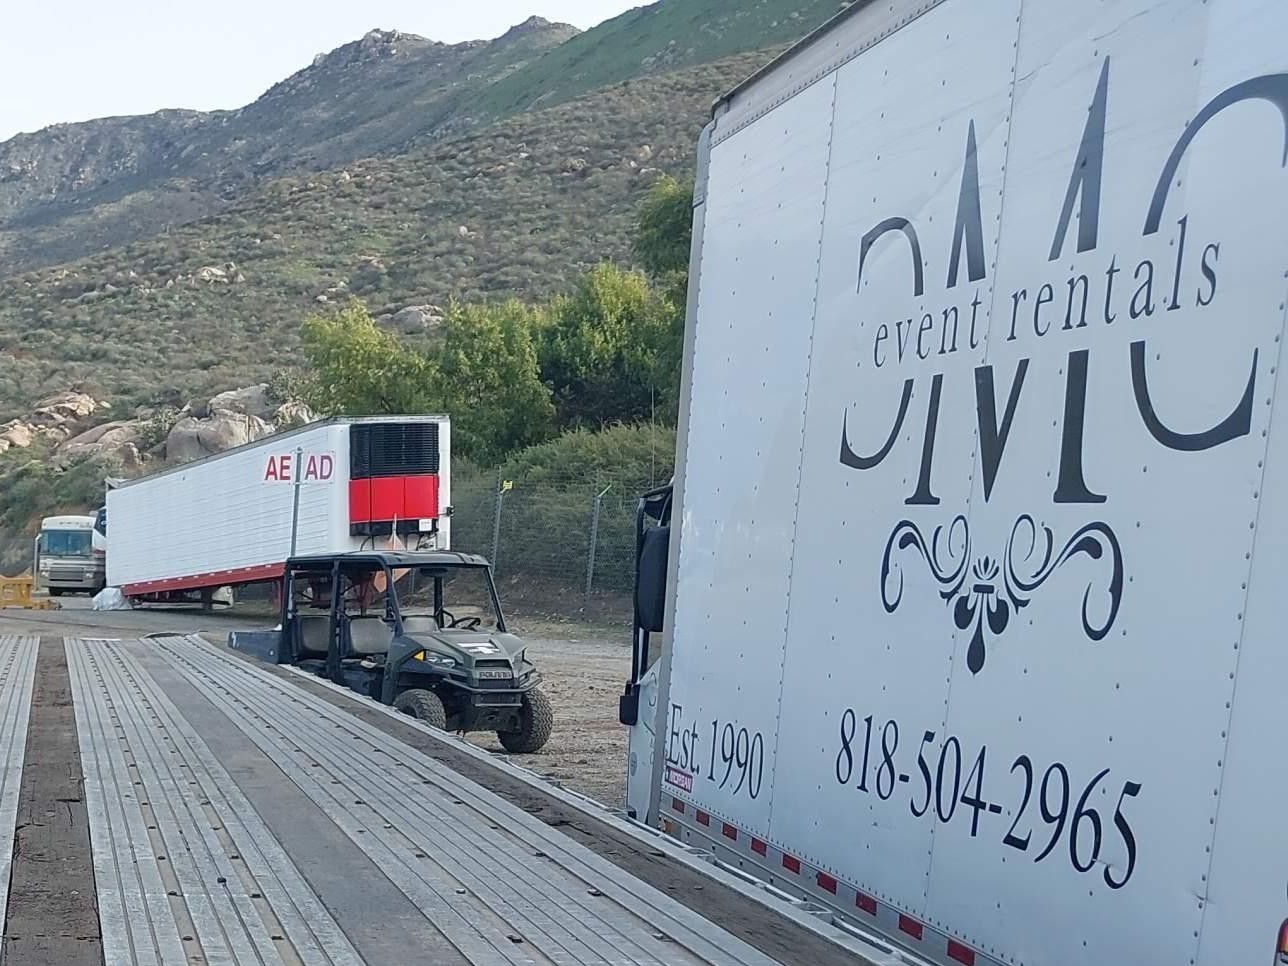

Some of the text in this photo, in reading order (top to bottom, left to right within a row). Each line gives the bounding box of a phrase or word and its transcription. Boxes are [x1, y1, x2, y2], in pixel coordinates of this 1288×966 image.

[874, 214, 1222, 368] event rentals
[665, 703, 764, 800] Est. 1990
[836, 708, 1142, 890] 818-504-2965
